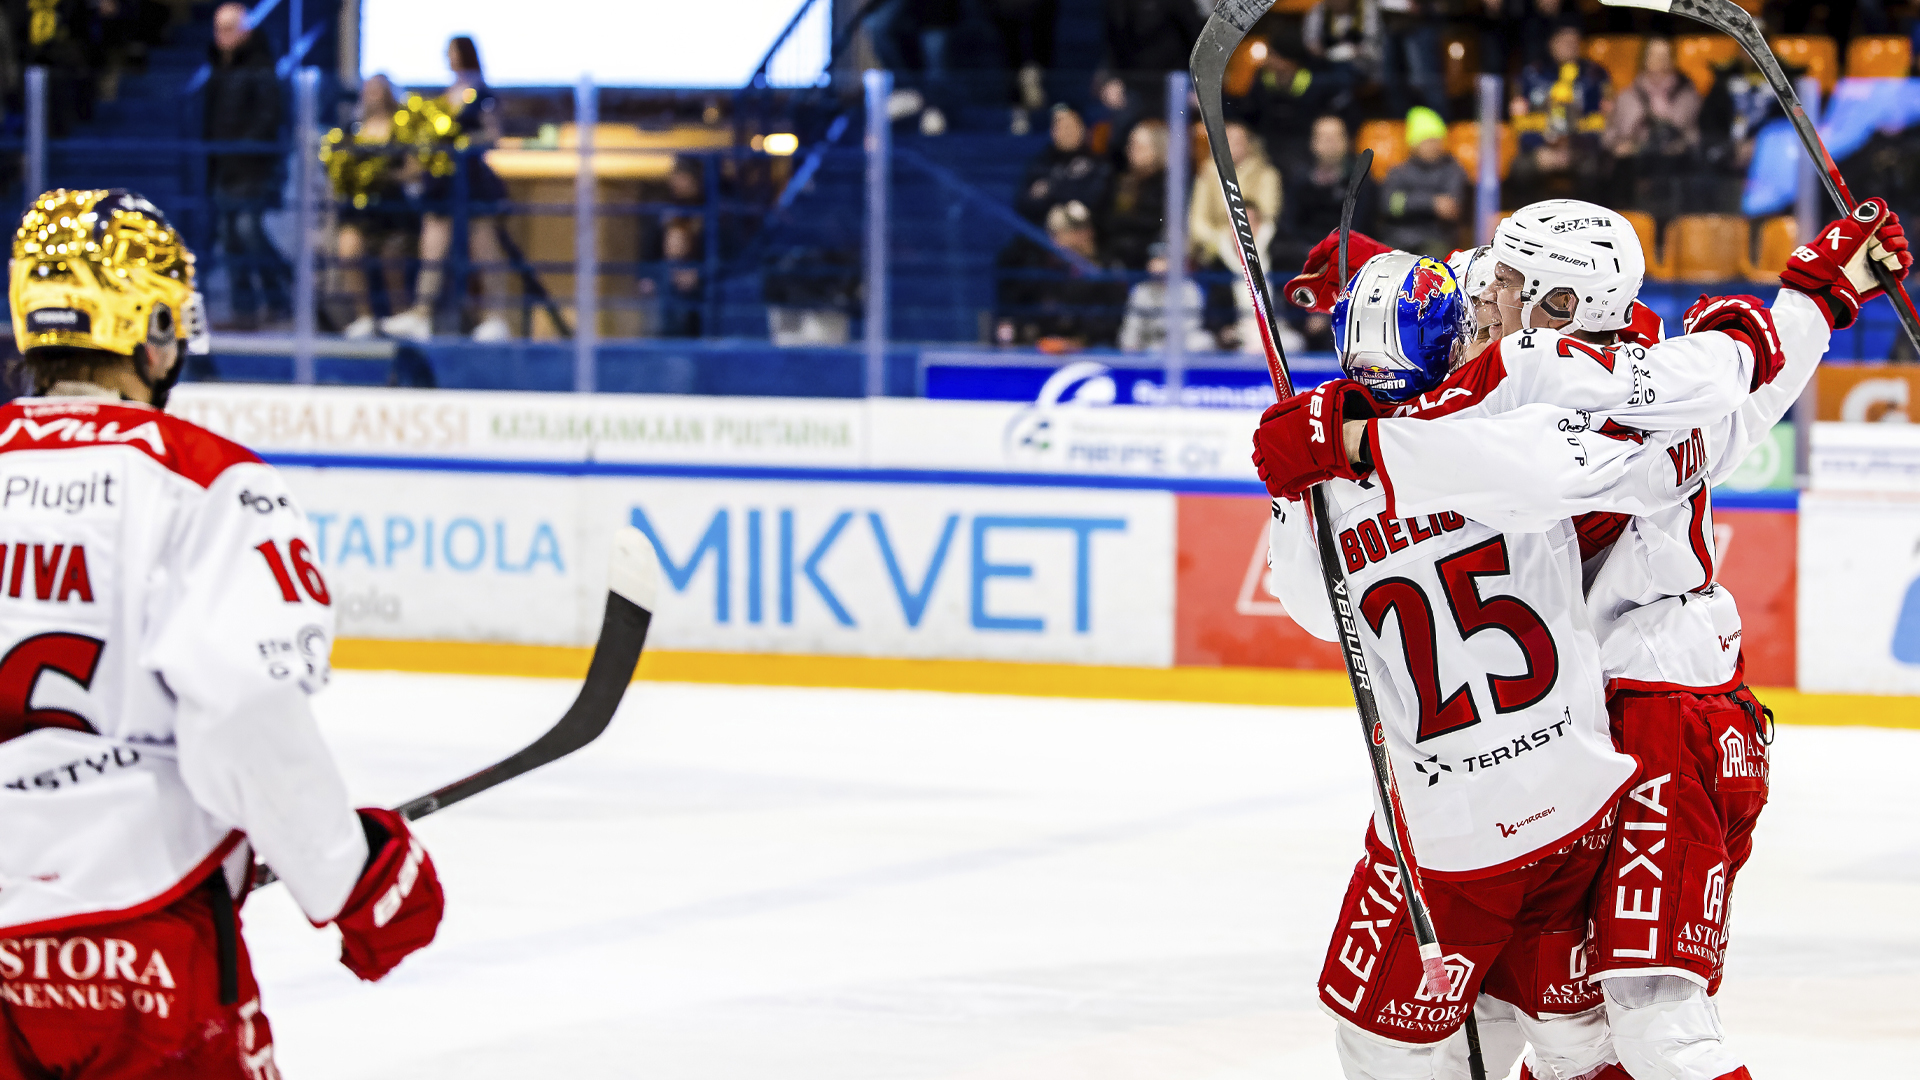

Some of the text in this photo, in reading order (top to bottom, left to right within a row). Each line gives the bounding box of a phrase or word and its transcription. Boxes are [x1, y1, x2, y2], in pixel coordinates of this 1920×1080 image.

[1226, 179, 1259, 264] FLYLITE
[1550, 217, 1612, 235] CRAFT
[4, 472, 115, 514] Plugit
[0, 543, 95, 603] IVA
[255, 538, 332, 607] 16
[308, 512, 566, 575] TAPIOLA
[630, 507, 1127, 633] MIKVET
[1336, 598, 1372, 691] BAUER
[1358, 533, 1559, 745] 25
[1613, 772, 1672, 960] LEXIA
[1324, 862, 1404, 1014] LEXIA
[1380, 998, 1469, 1023] ASTORA
[1542, 979, 1592, 997] AST
[1376, 1014, 1450, 1033] RAKENNUS
